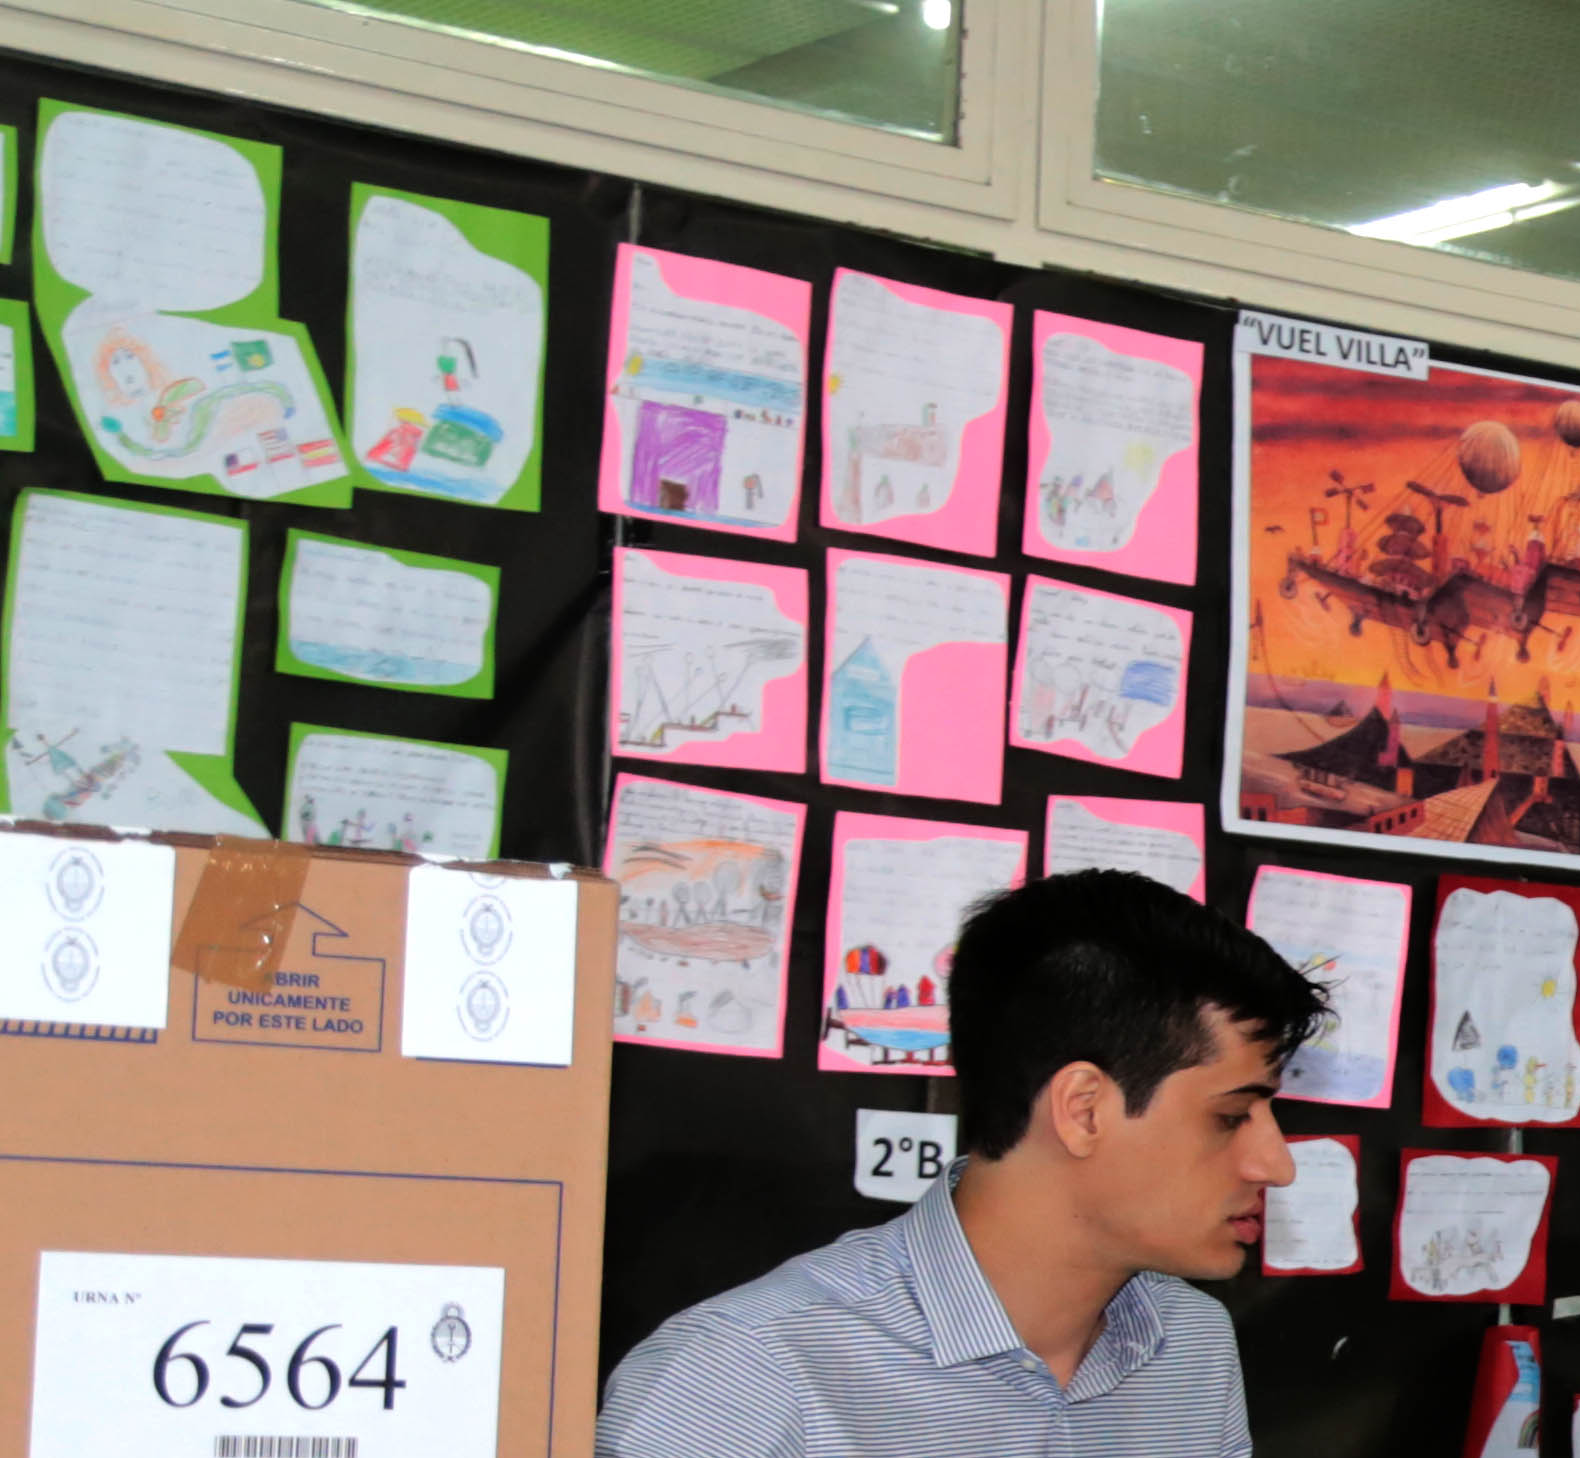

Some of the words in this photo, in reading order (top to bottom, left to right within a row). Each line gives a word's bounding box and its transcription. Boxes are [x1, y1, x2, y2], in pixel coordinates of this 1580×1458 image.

[262, 971, 320, 988] BRIR
[228, 991, 350, 1012] UNICAMENTE
[213, 1010, 252, 1026] POR
[259, 1014, 306, 1030] ESTE
[312, 1018, 364, 1034] LADO
[74, 1291, 119, 1304] URNA
[153, 1319, 407, 1410] 6564
